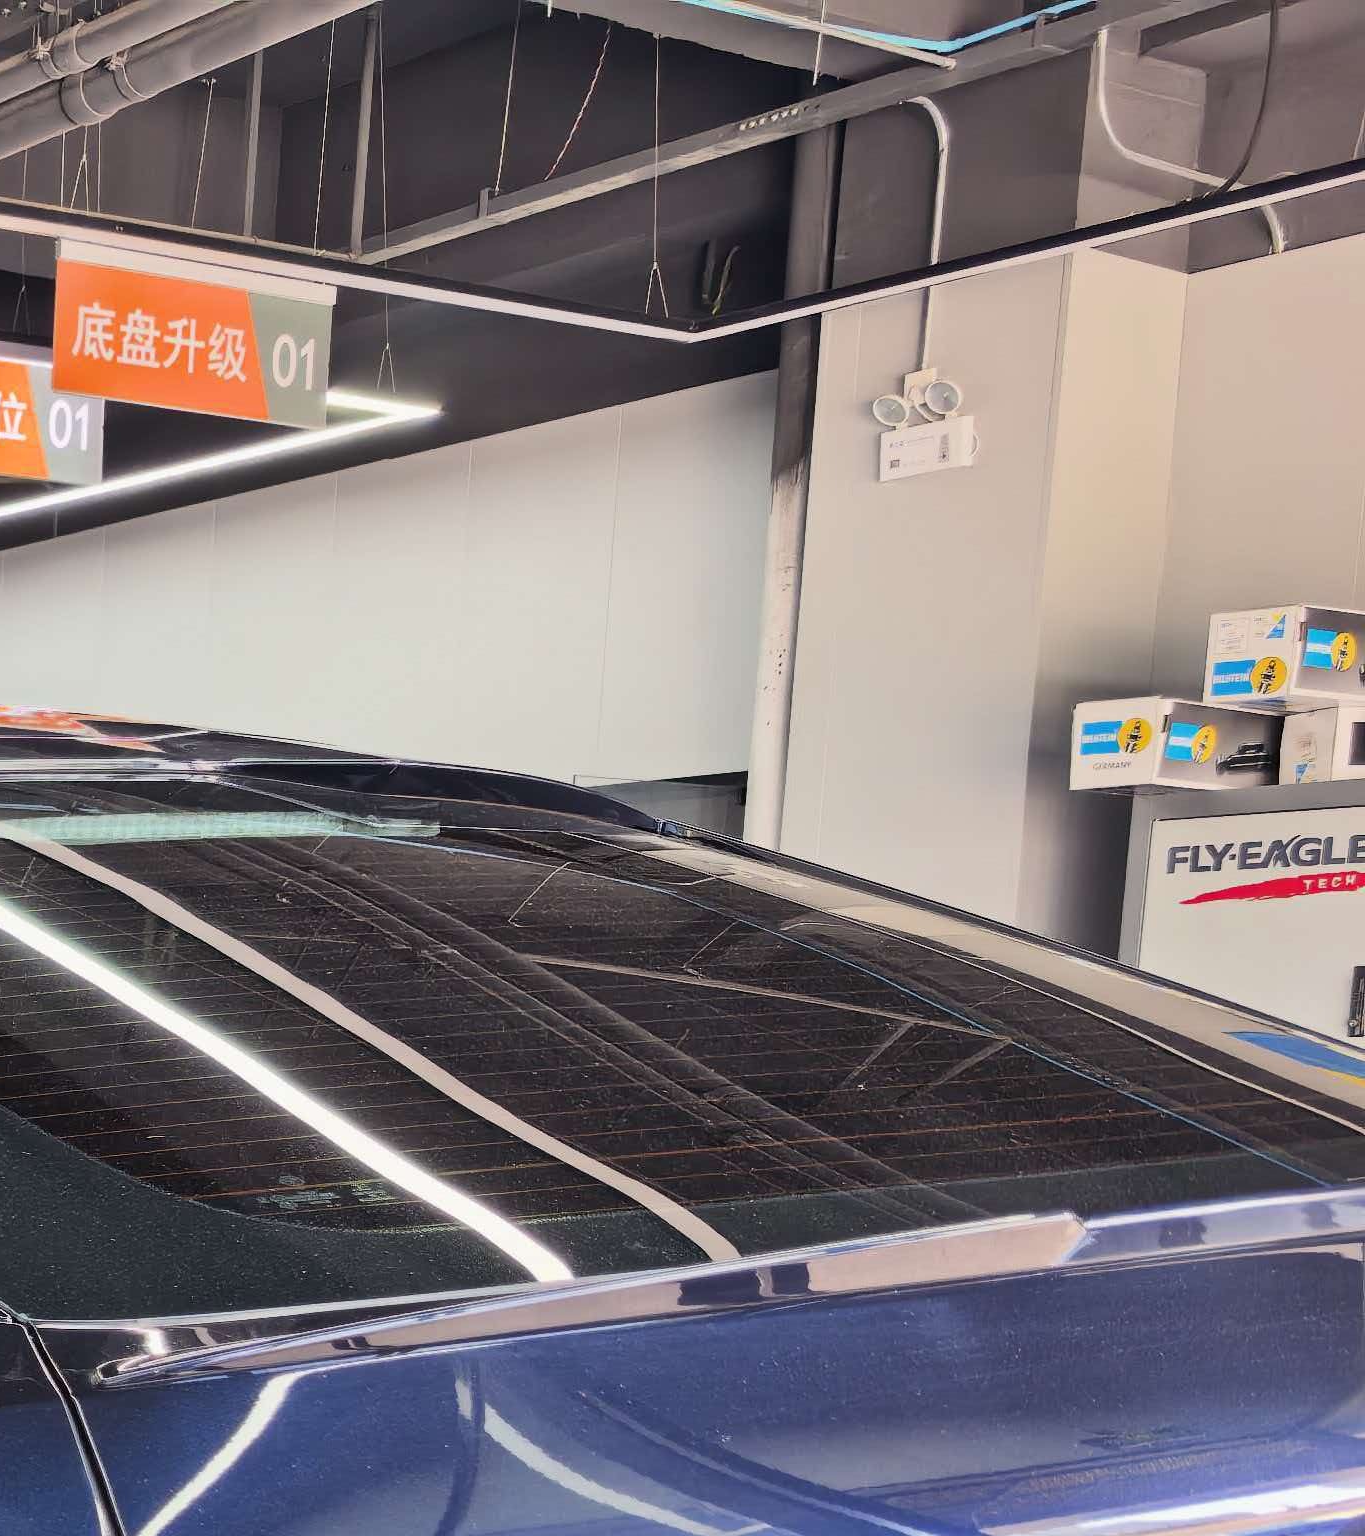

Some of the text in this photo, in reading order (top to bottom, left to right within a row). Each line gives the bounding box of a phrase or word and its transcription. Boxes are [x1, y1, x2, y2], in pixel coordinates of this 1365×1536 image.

[71, 302, 316, 391] 底盘升级 01
[48, 399, 90, 452] 01
[1303, 874, 1357, 891] TECH
